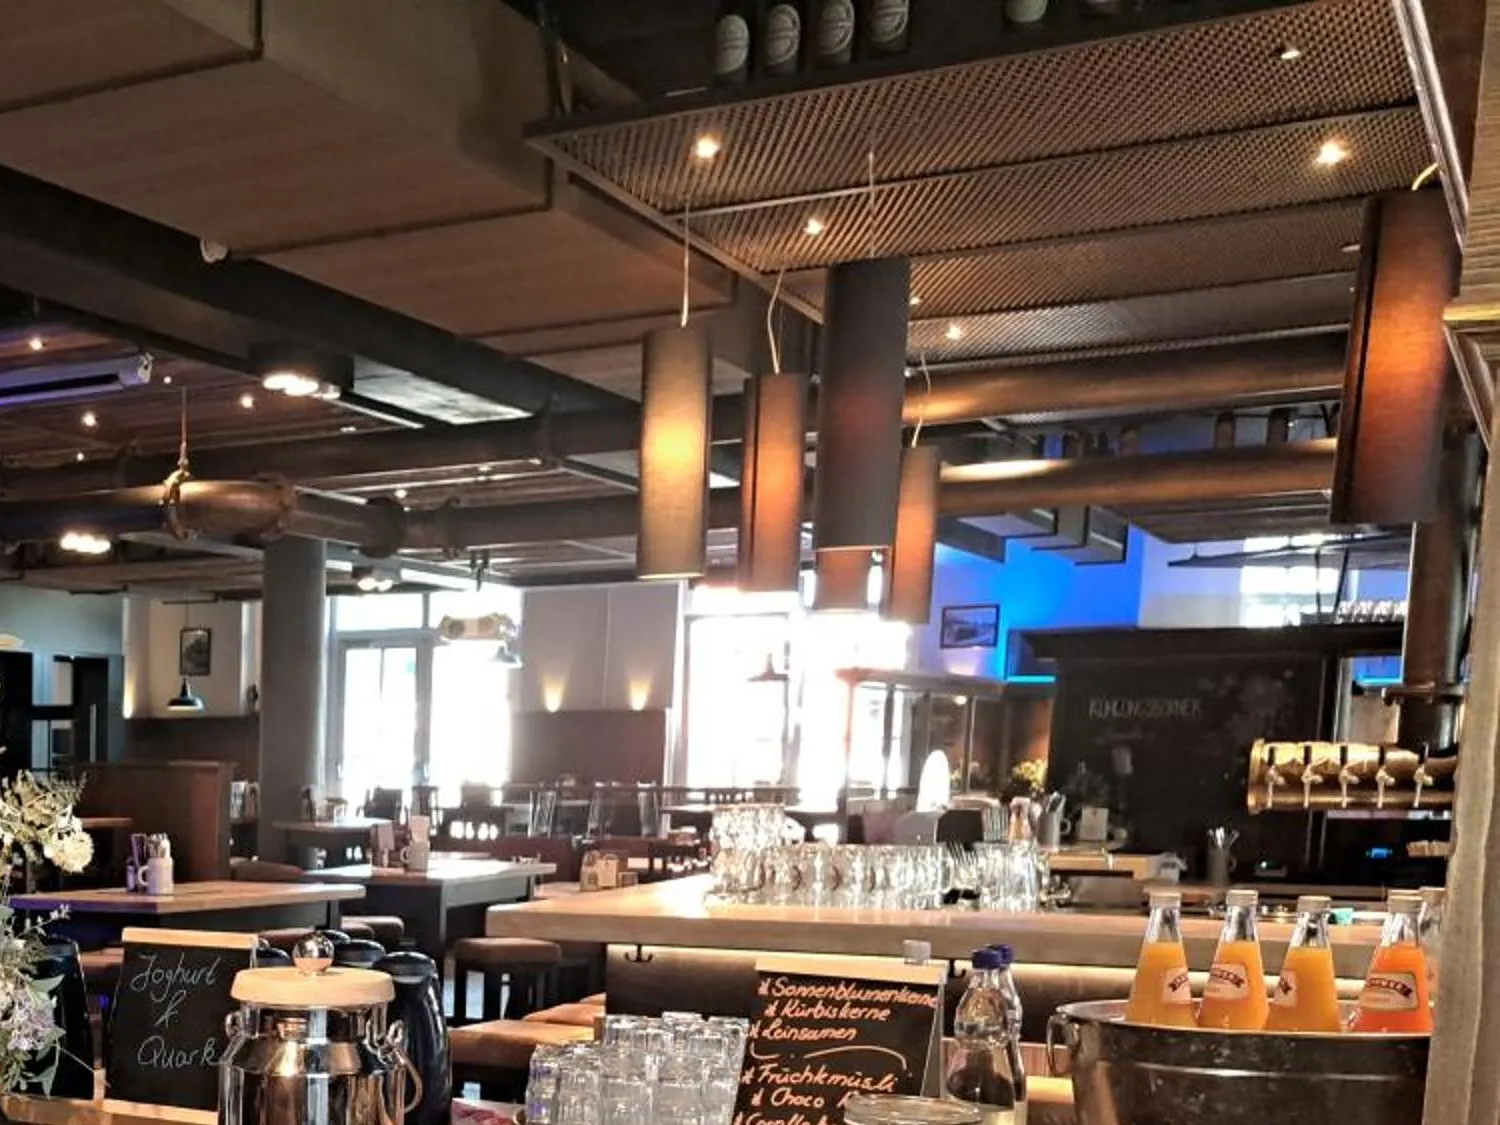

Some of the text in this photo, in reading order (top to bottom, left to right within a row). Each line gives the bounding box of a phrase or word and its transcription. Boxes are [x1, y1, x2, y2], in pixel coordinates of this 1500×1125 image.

[130, 952, 221, 1003] Joghurt
[762, 1018, 857, 1041] Leinsamen
[137, 1035, 224, 1068] Quark
[770, 1086, 825, 1108] Choco
